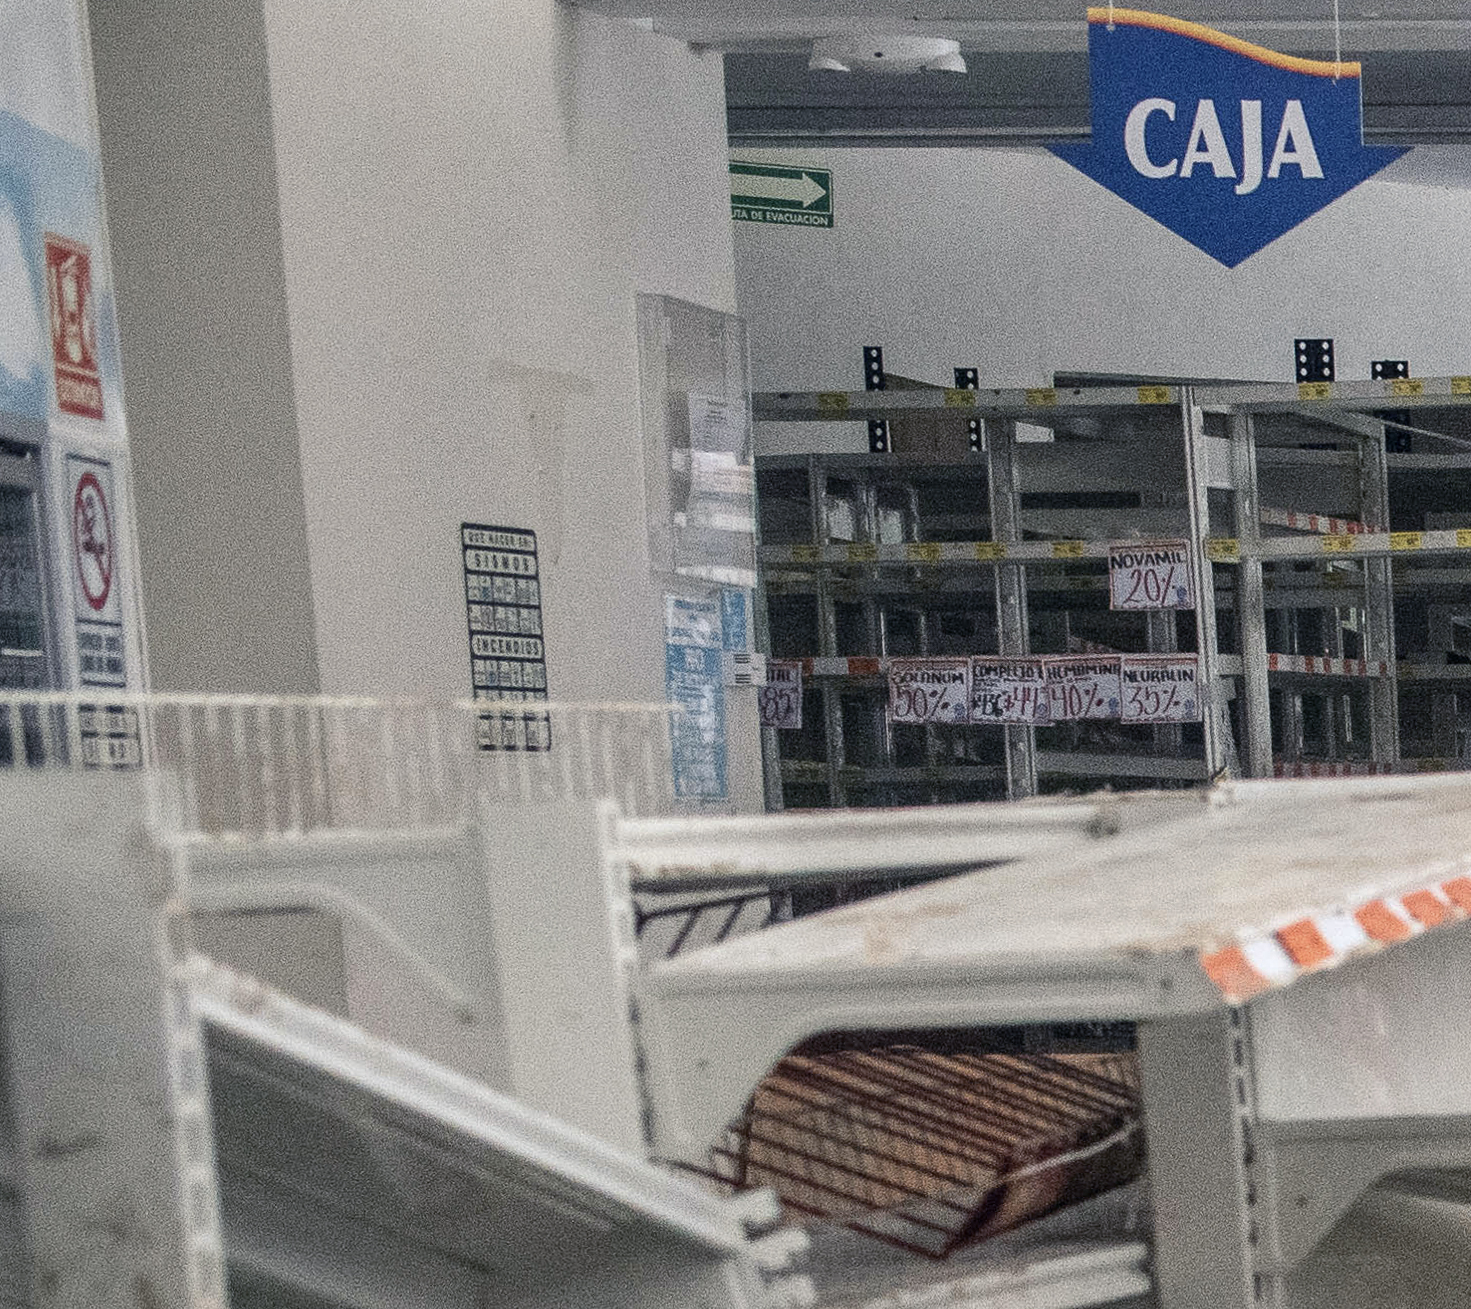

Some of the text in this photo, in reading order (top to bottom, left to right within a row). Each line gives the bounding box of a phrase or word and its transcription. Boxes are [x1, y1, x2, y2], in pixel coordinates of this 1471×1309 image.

[1122, 97, 1325, 196] CAJA
[474, 553, 530, 572] SISMOS
[1111, 551, 1187, 569] NOVAMIL
[1123, 566, 1176, 606] 20%
[475, 637, 540, 656] INCENDIOS
[895, 684, 950, 719] 50%
[1051, 683, 1105, 717] 40%
[1128, 684, 1181, 717] 35%
